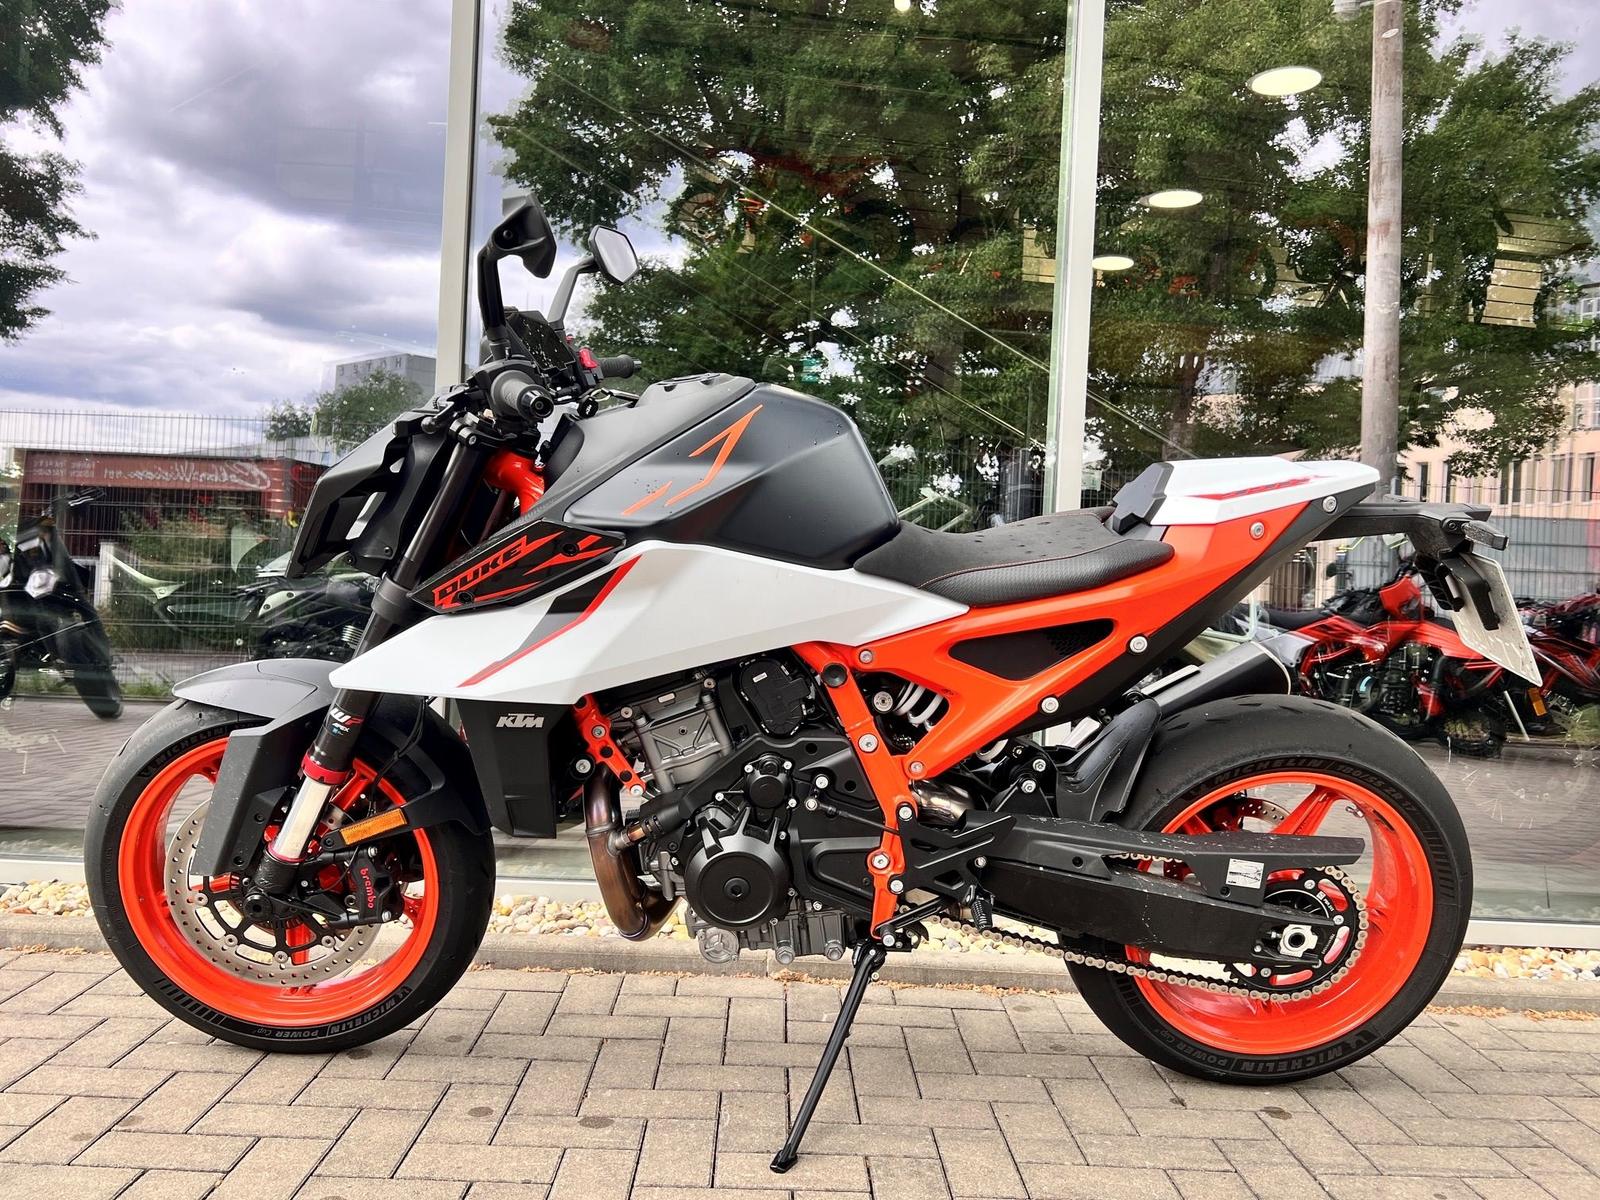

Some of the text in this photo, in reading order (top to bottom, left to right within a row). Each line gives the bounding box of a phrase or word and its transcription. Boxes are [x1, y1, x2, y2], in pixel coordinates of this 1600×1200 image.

[437, 543, 524, 600] DUKE
[330, 707, 364, 727] WP
[496, 713, 545, 728] KTM
[152, 727, 225, 767] MICHELIN
[1213, 756, 1323, 786] MICHELIN
[360, 867, 376, 909] brembo
[329, 999, 396, 1035] MICHELIN
[274, 1029, 319, 1038] POWER
[1176, 1043, 1228, 1066] POWER
[1239, 1044, 1343, 1073] MICHELIN
